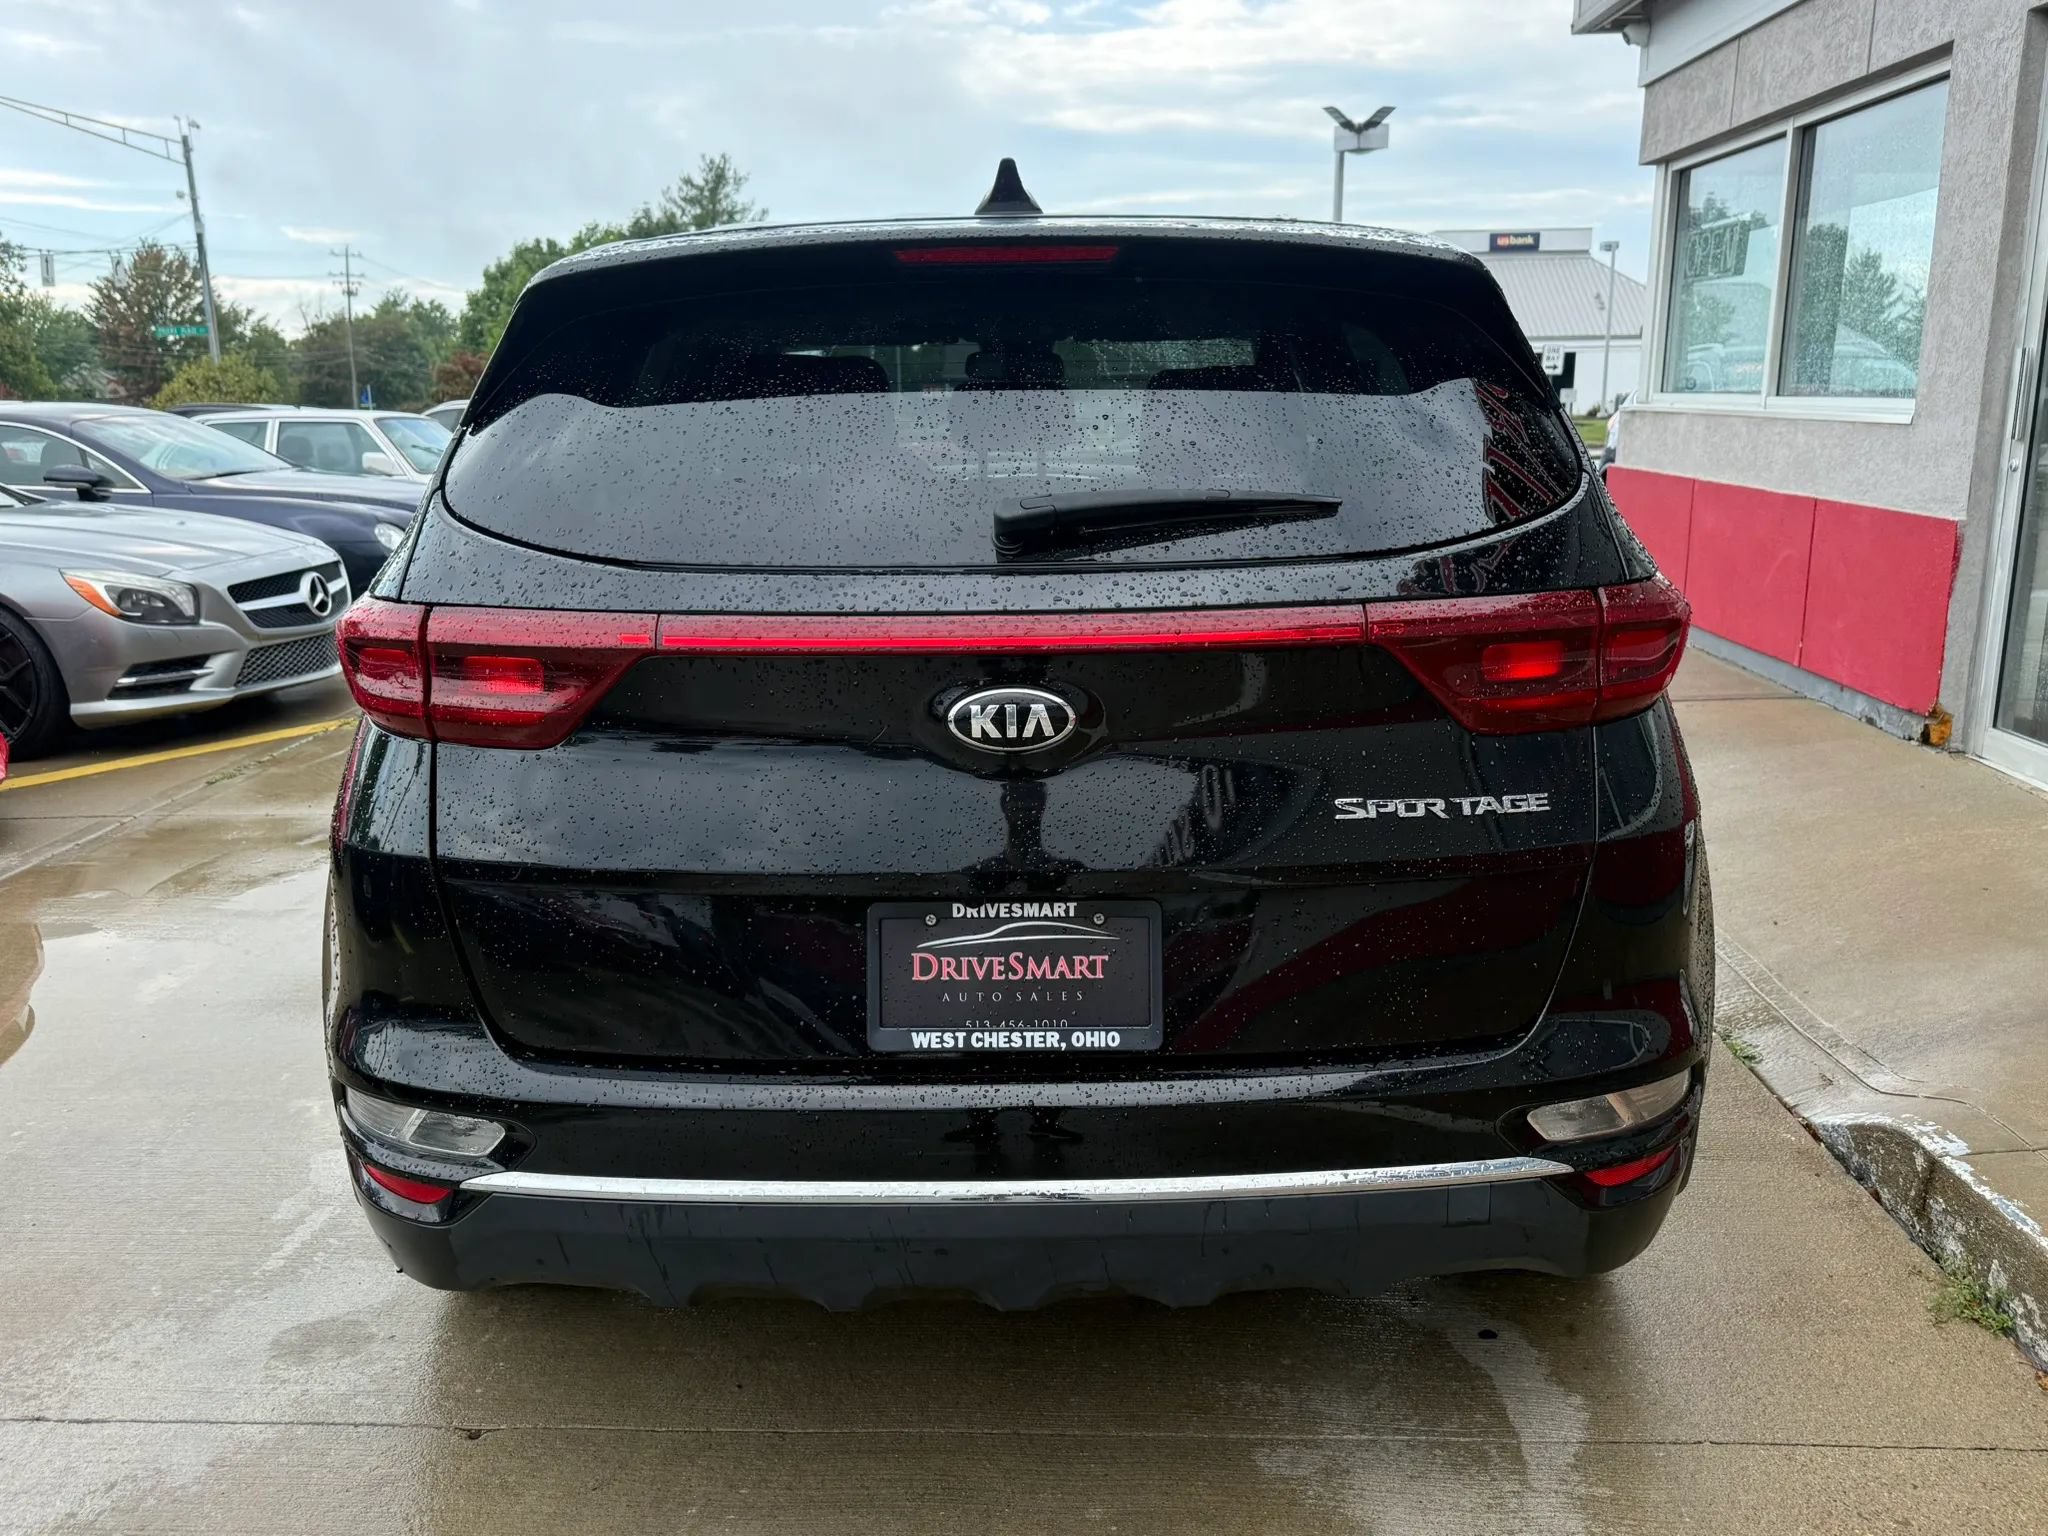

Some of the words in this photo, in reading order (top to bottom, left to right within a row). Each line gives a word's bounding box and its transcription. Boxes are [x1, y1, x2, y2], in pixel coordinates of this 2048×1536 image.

[1685, 225, 1740, 276] OPEN
[969, 704, 1055, 738] KIA
[1334, 793, 1550, 819] SPORTAGE
[952, 902, 1077, 918] DRIVESMART
[942, 991, 1002, 1002] AUTO
[1016, 990, 1083, 1001] SALES
[911, 1032, 966, 1049] WEST
[971, 1031, 1067, 1050] CHESTER,
[1071, 1031, 1121, 1048] OHIO
